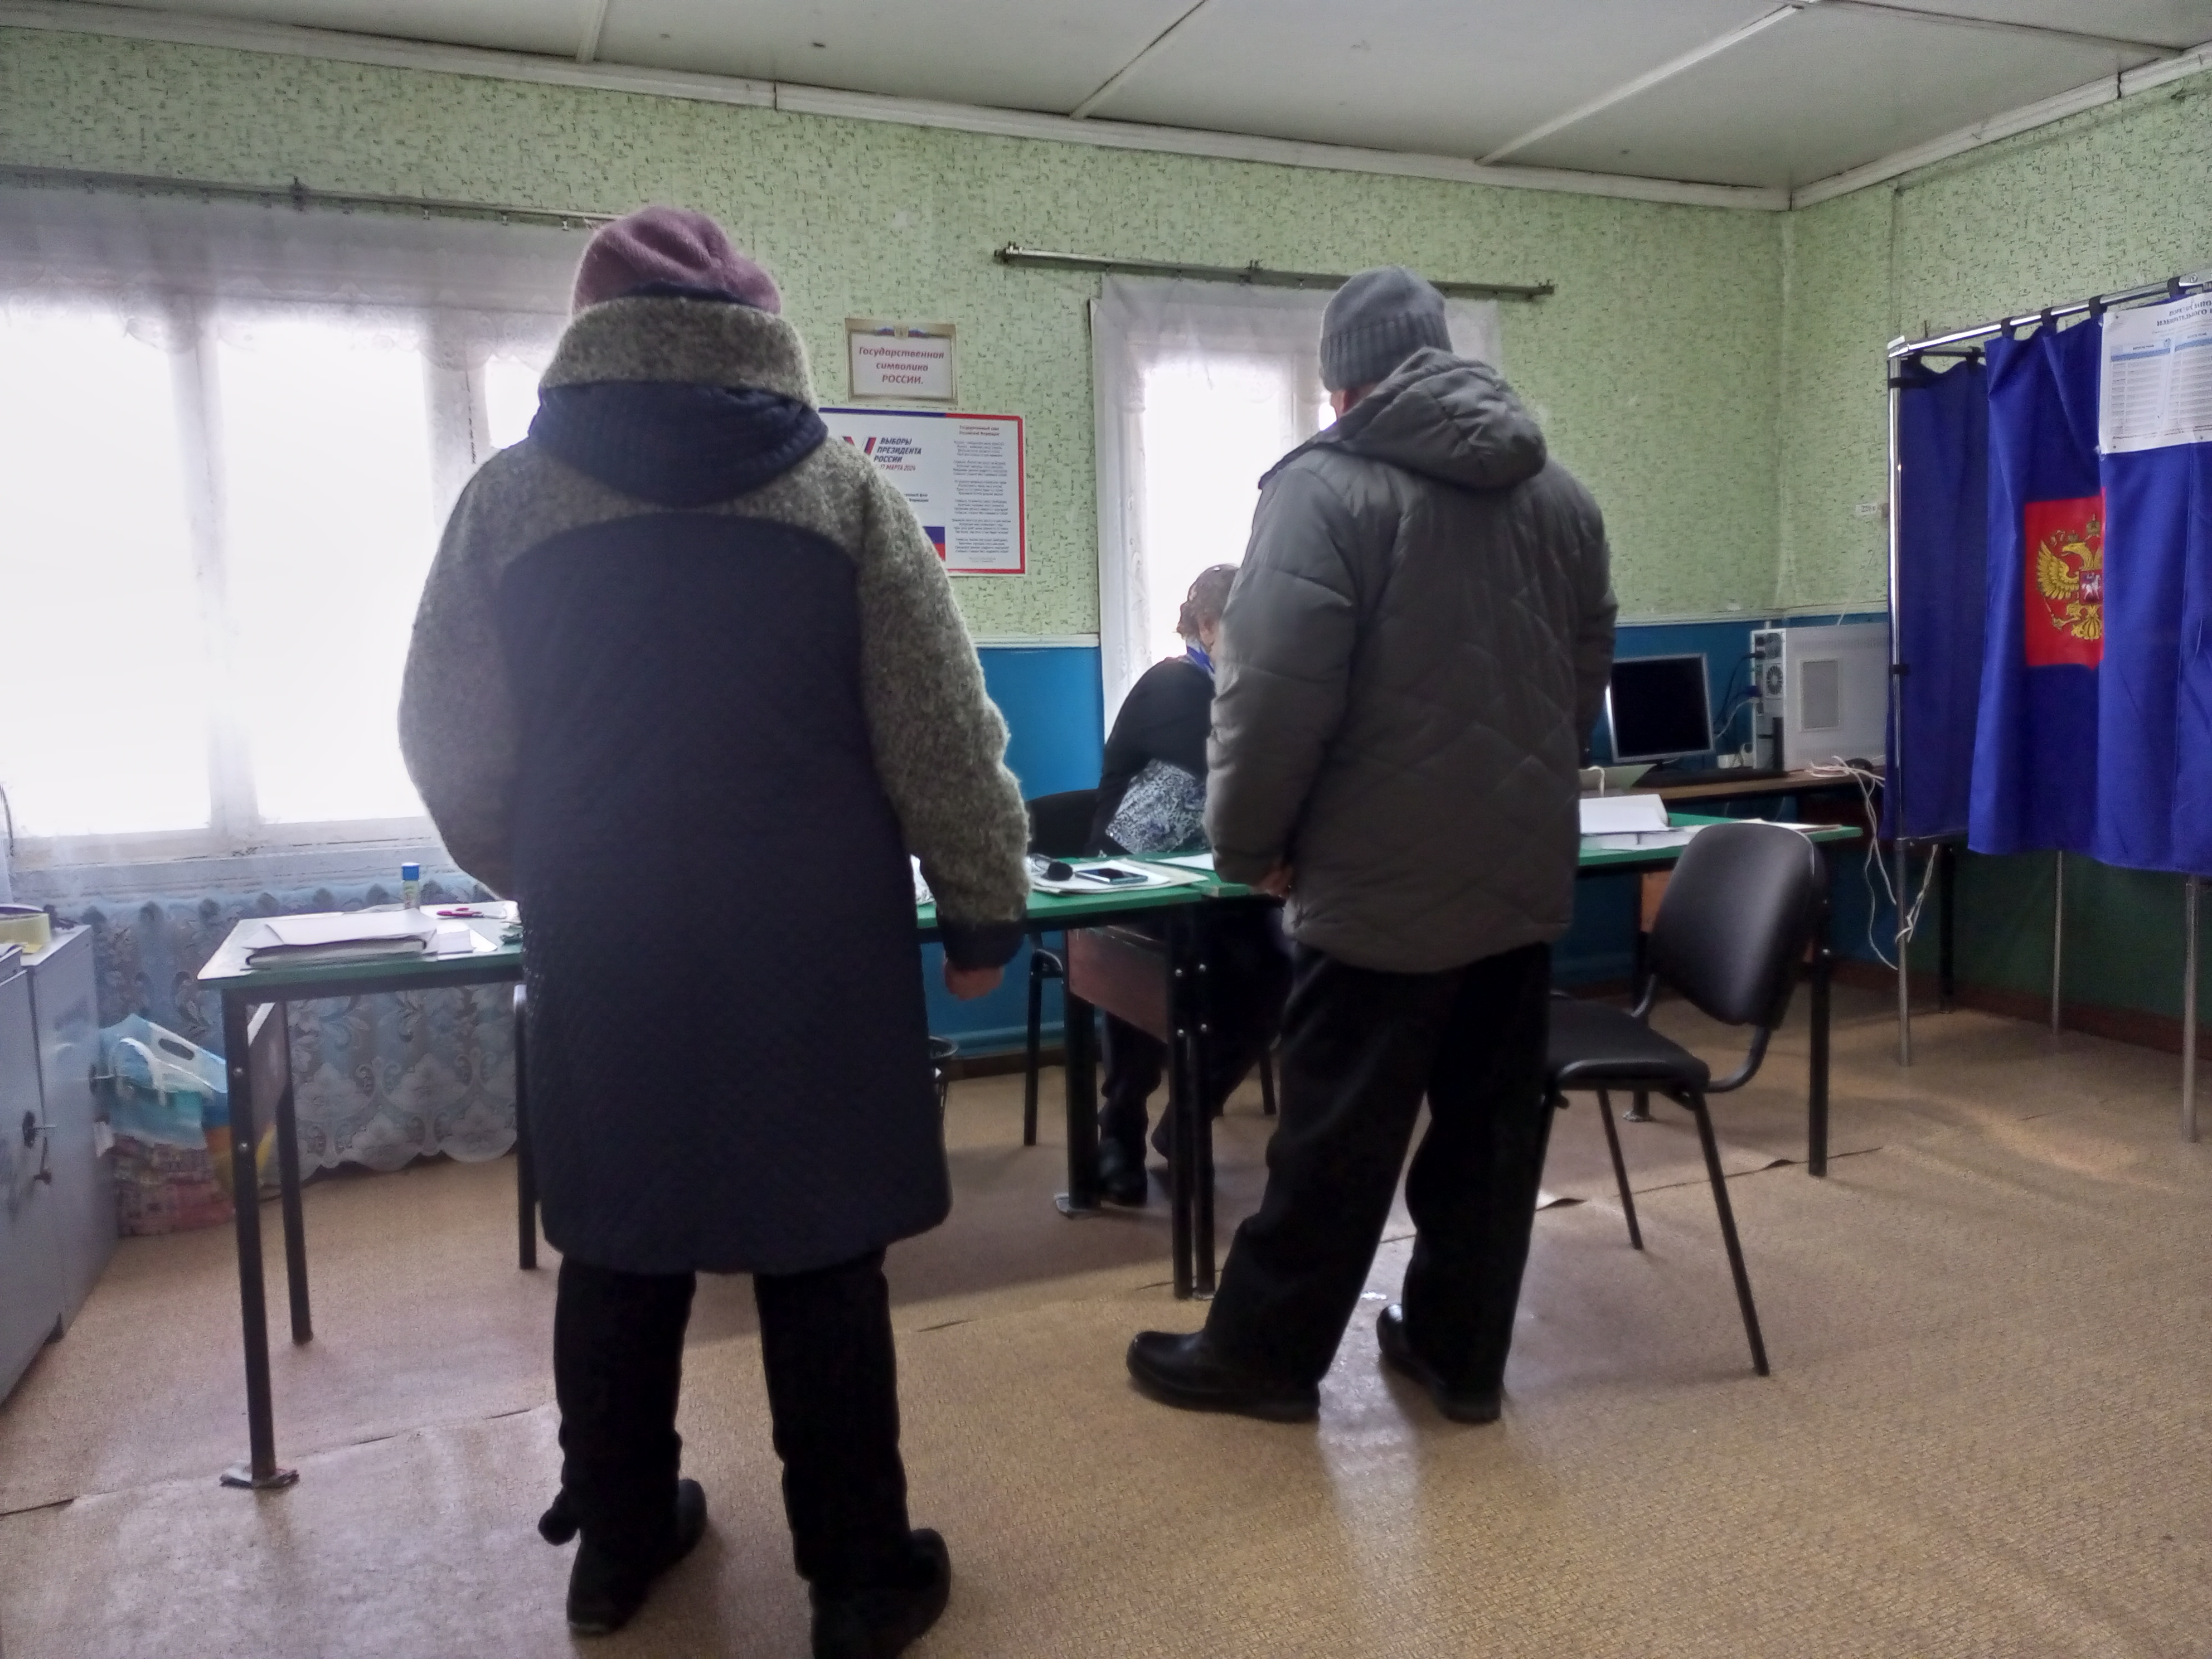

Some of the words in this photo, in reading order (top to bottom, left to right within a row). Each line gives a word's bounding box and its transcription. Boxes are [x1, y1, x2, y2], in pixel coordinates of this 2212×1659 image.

[859, 346, 945, 359] Государственная
[876, 362, 929, 372] символика
[882, 374, 924, 385] РОССИИ.
[880, 436, 913, 446] ВЫБОРЫ
[876, 446, 922, 455] ПРЕЗИДЕНТА
[873, 455, 903, 463] РОССИИ
